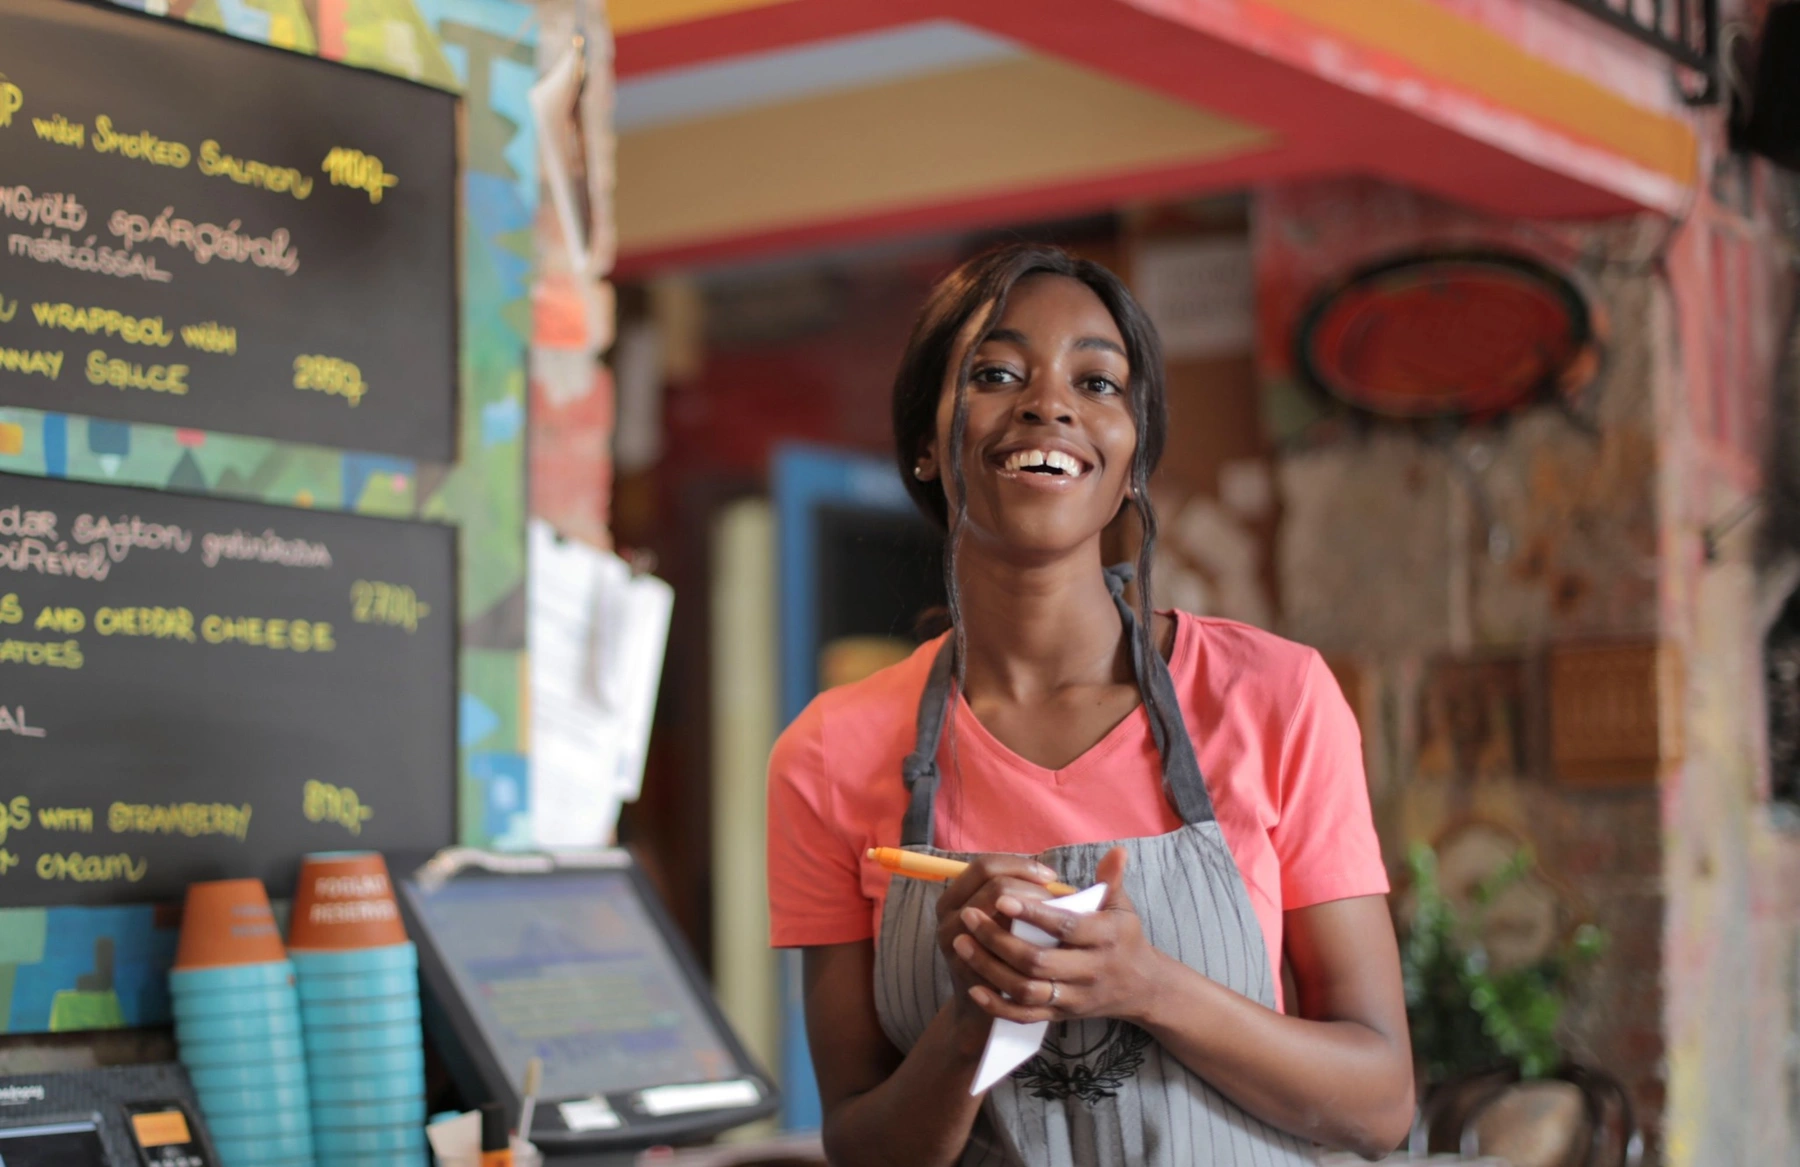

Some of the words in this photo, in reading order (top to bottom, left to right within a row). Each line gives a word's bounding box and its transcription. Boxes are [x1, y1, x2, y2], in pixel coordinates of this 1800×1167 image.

[35, 607, 87, 633] AND
[95, 607, 197, 643] CHEDDAR
[202, 615, 336, 652] CHEESE
[38, 807, 94, 833] WITH
